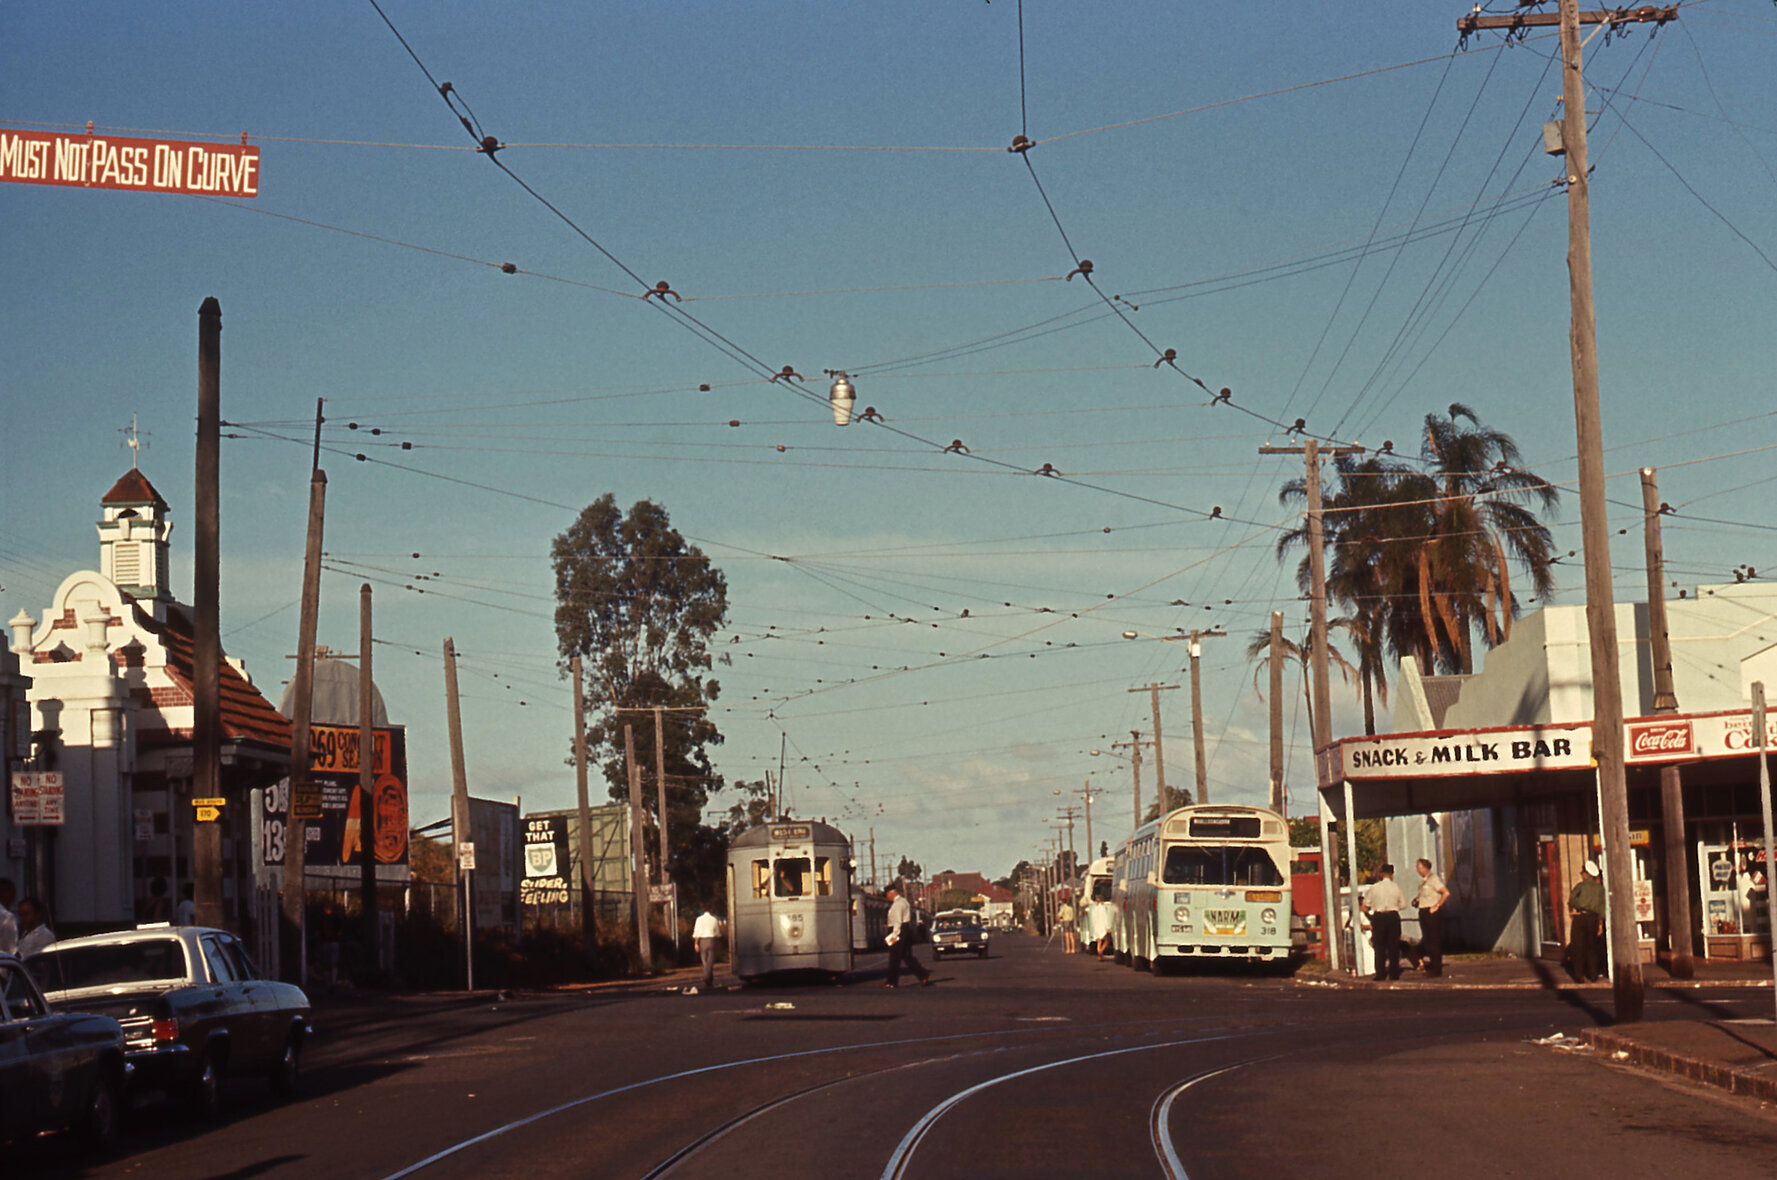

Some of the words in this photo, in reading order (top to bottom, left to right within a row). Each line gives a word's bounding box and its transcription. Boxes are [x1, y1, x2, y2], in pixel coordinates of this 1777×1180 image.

[0, 133, 51, 179] MUST
[54, 137, 89, 182] NOT
[91, 140, 148, 185] PASS
[153, 144, 182, 188] ON
[187, 147, 259, 194] CURVE
[1353, 747, 1409, 769] SNACK
[1415, 751, 1426, 764] &
[1431, 743, 1499, 763] MILK
[1512, 738, 1571, 759] BAR
[20, 775, 32, 786] NO
[45, 774, 58, 784] NO
[529, 820, 550, 831] GET
[525, 831, 555, 842] THAT
[531, 851, 553, 866] BP
[1261, 927, 1277, 935] 318
